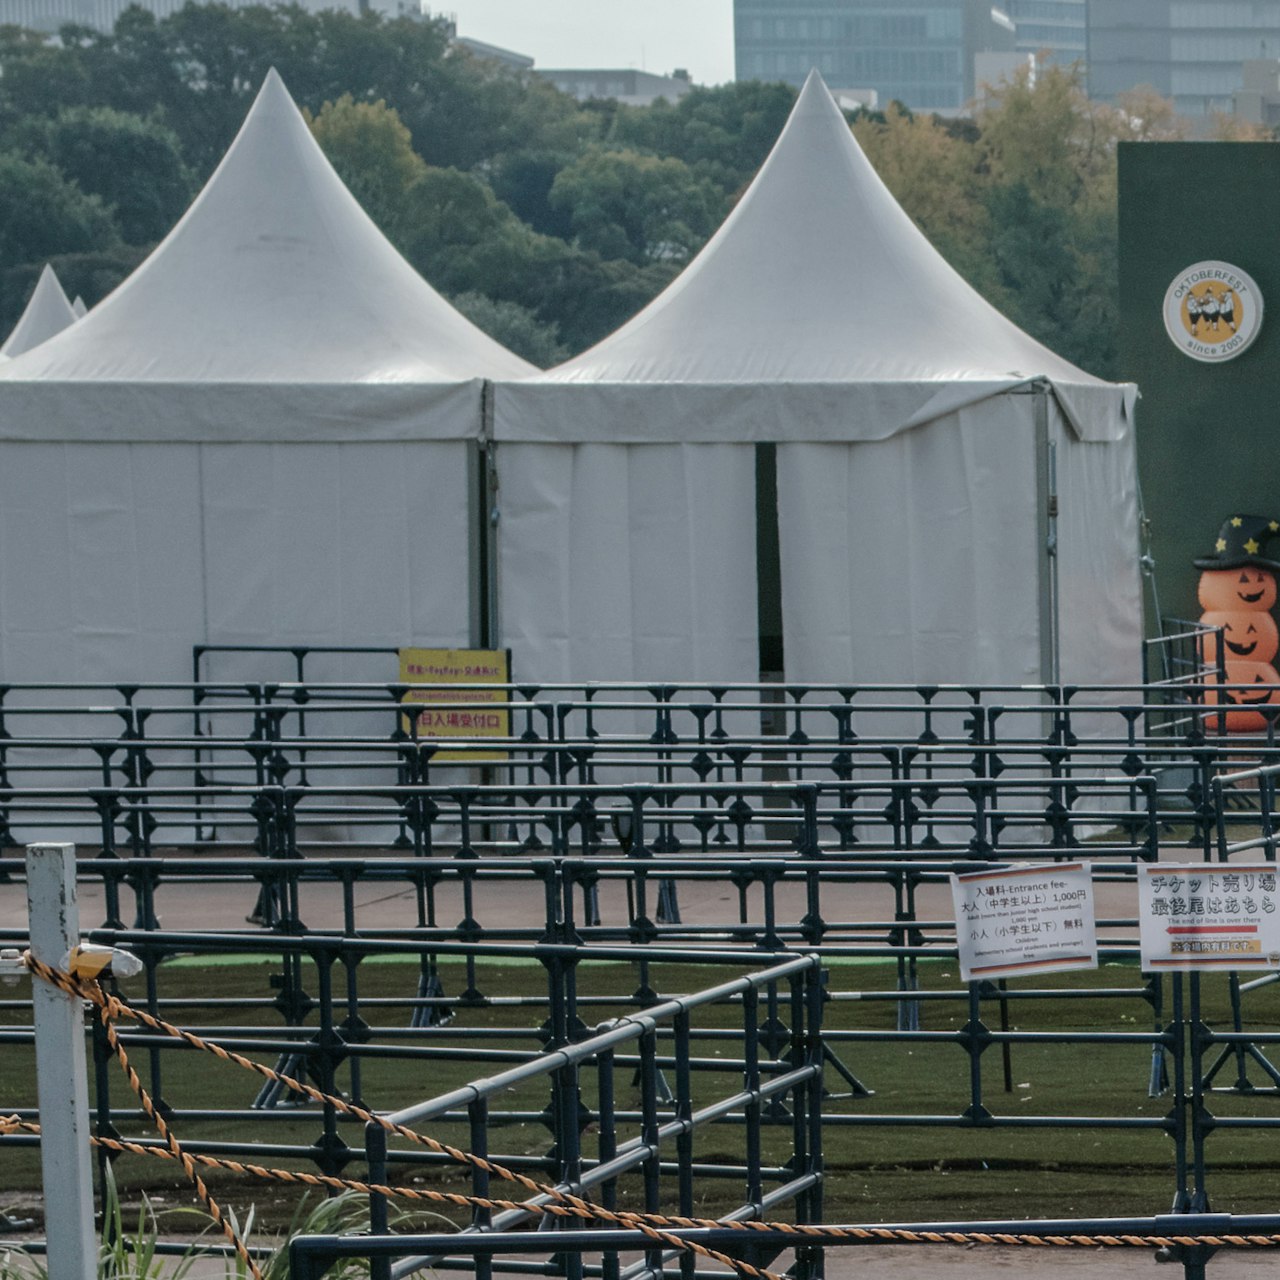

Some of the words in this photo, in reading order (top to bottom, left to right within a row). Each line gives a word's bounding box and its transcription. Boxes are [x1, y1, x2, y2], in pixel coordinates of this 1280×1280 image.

[1174, 269, 1247, 299] OKTOBERFEST
[1187, 340, 1217, 355] since
[1221, 334, 1244, 353] 2003
[1151, 873, 1277, 894] チケット売り場
[1053, 889, 1087, 903] 1,000円
[1151, 896, 1276, 916] 最後尾はあちら
[1063, 919, 1083, 929] 無料
